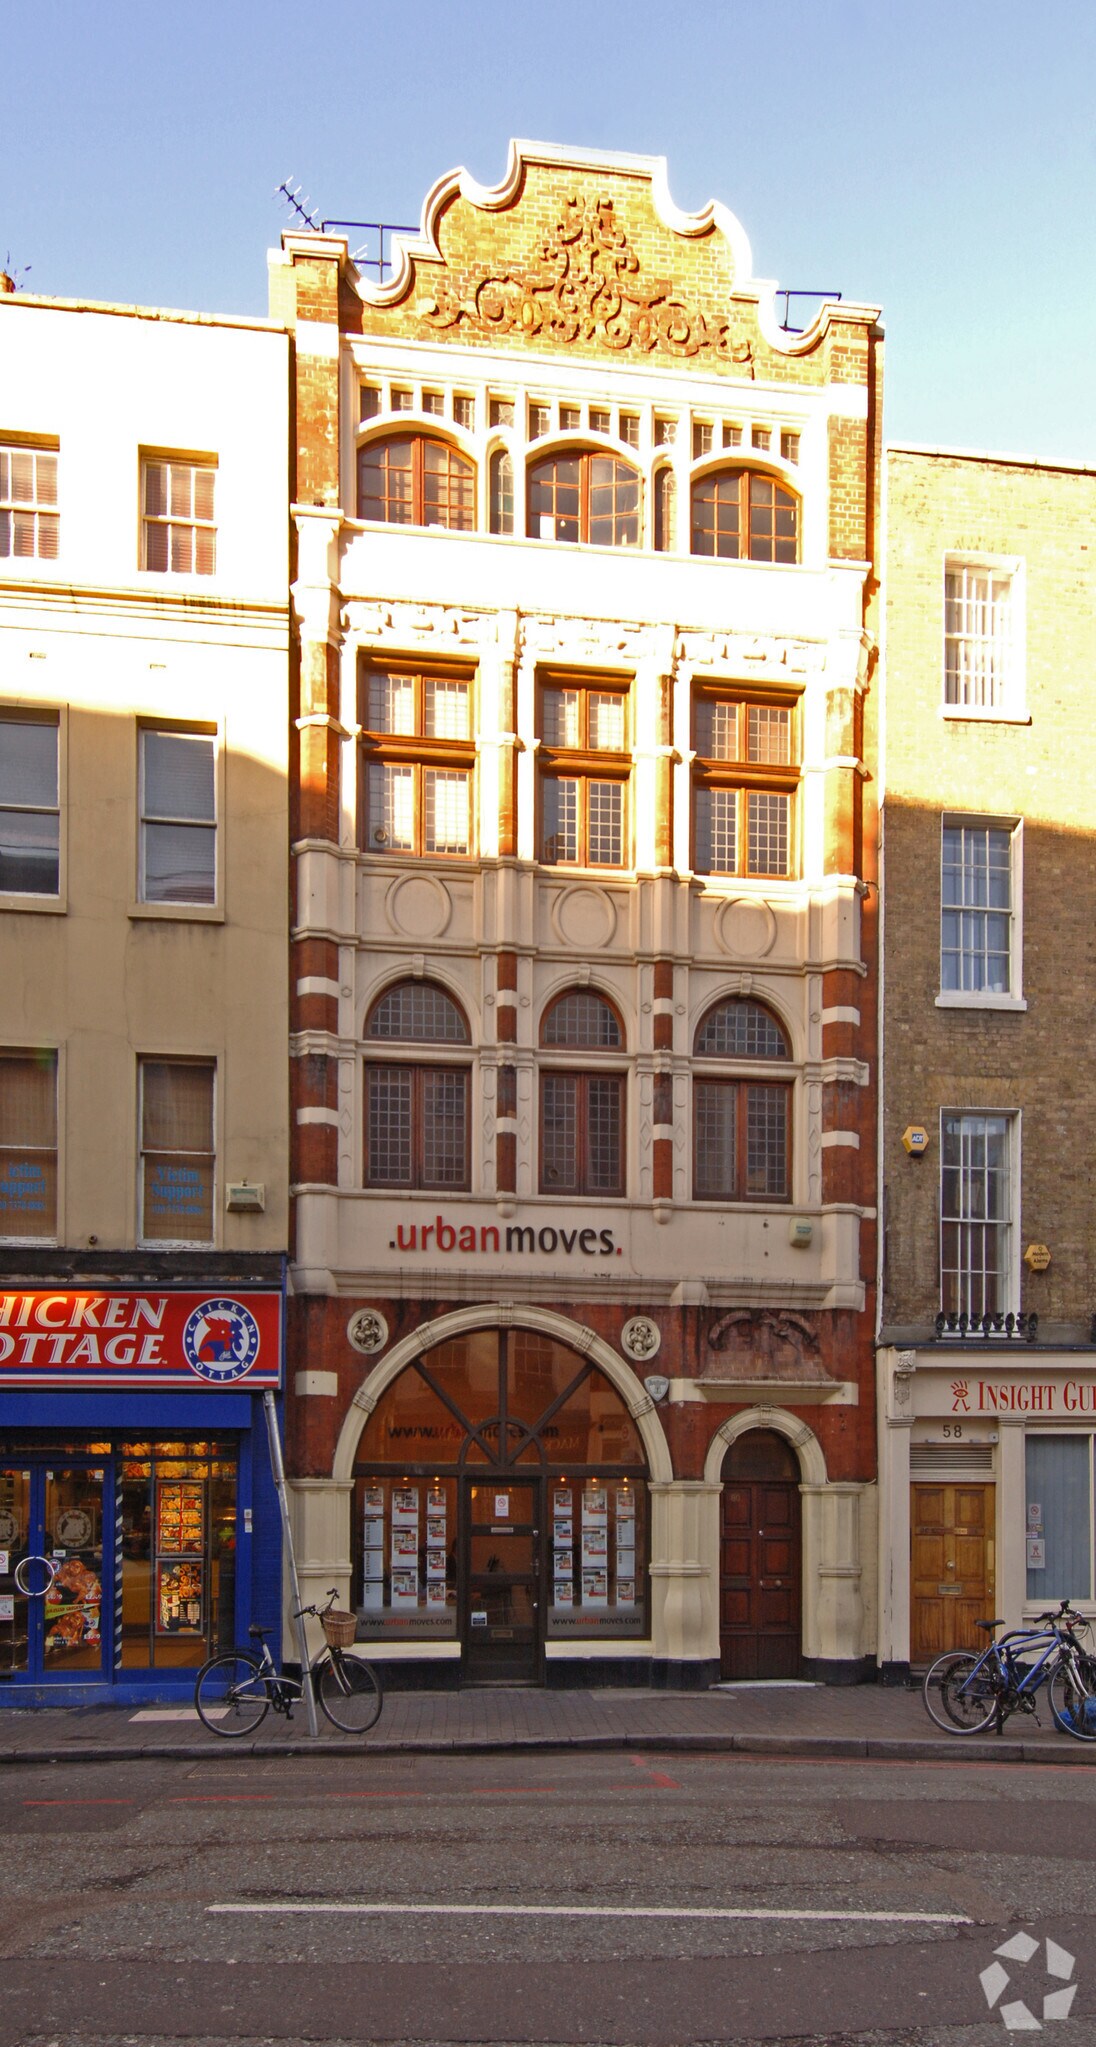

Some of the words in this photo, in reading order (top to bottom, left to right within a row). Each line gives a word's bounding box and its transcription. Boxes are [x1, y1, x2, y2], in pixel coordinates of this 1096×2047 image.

[156, 1166, 199, 1182] Victim
[151, 1182, 204, 1201] Support
[188, 1302, 255, 1333] CHICKEN
[188, 1350, 255, 1380] COTTAGE
[977, 1381, 1056, 1411] INSIGHT
[942, 1424, 963, 1439] 58
[360, 1617, 452, 1626] www.urbanmoves.com
[552, 1616, 640, 1625] www.urbanmoves.com
